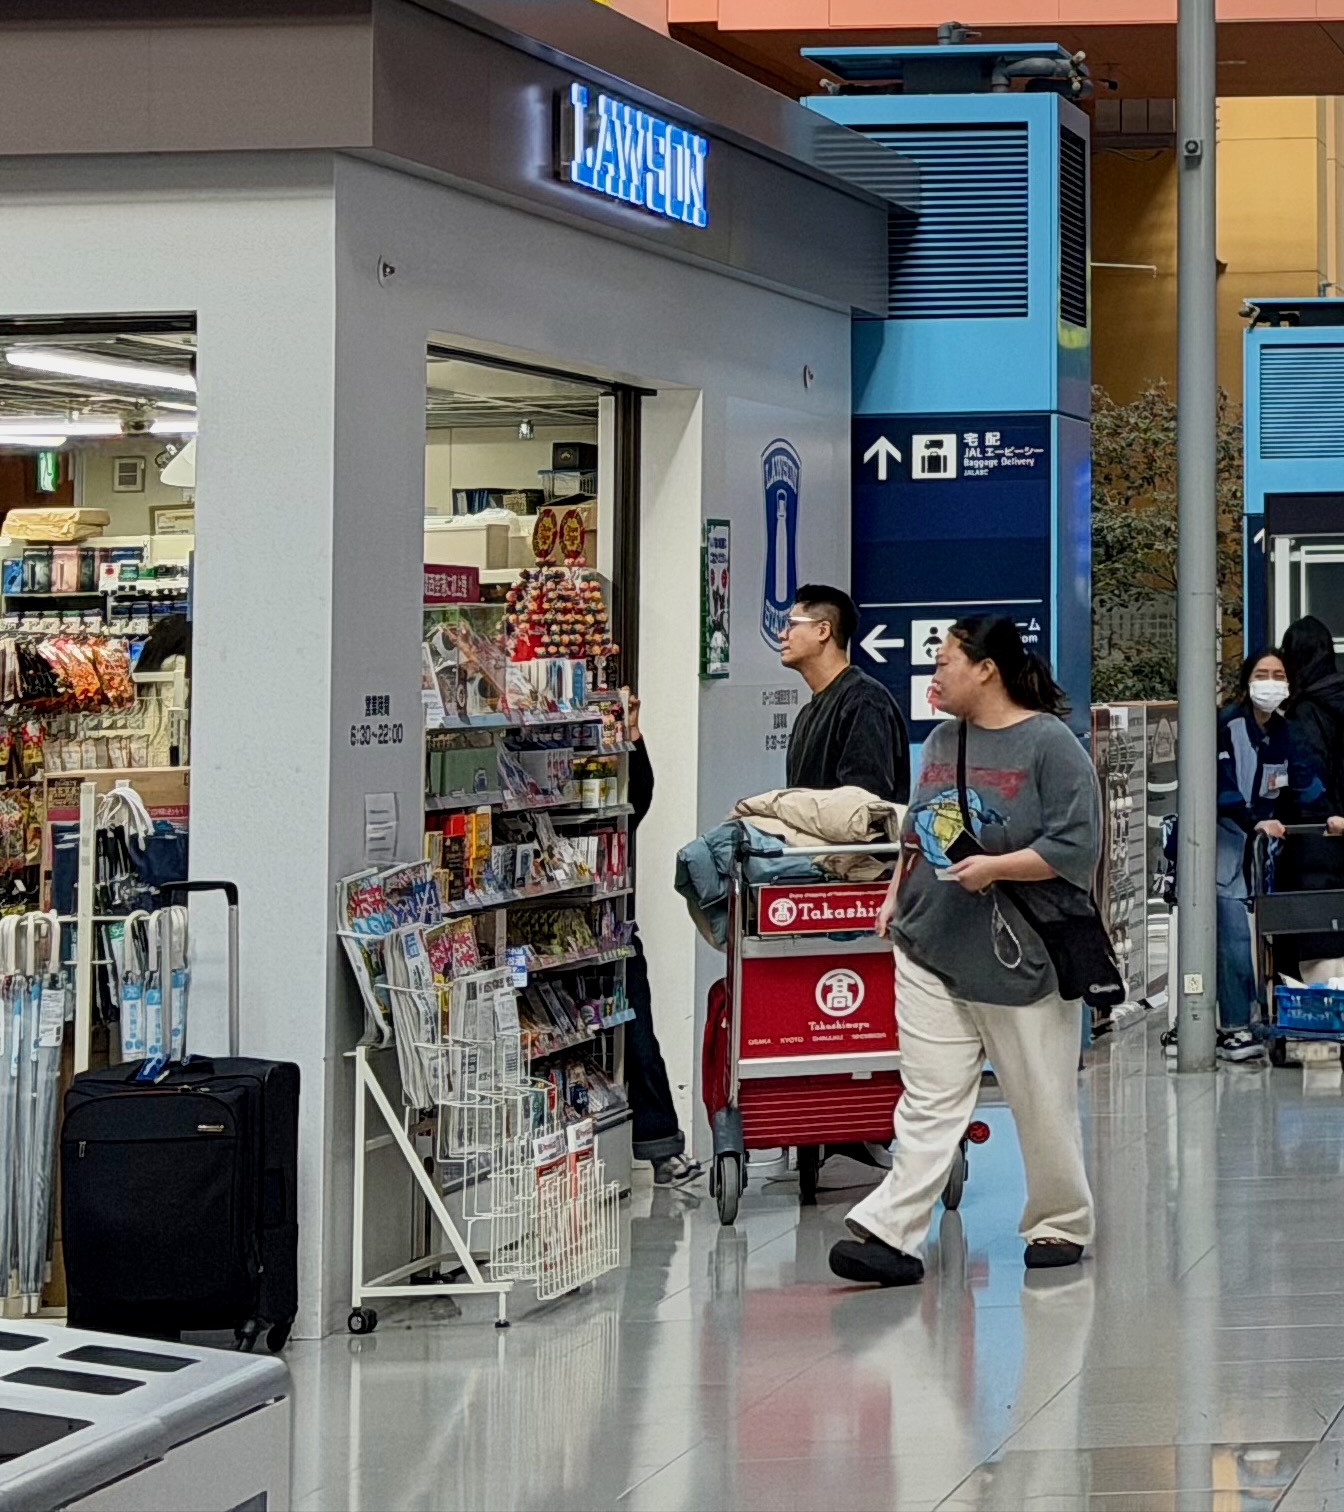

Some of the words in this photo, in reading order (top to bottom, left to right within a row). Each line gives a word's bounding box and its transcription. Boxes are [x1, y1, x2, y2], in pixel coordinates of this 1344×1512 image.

[571, 82, 708, 228] LAWSON
[964, 447, 983, 458] JAL
[963, 458, 998, 468] Baggage
[1001, 457, 1035, 467] Delivery
[798, 901, 881, 921] Takashi
